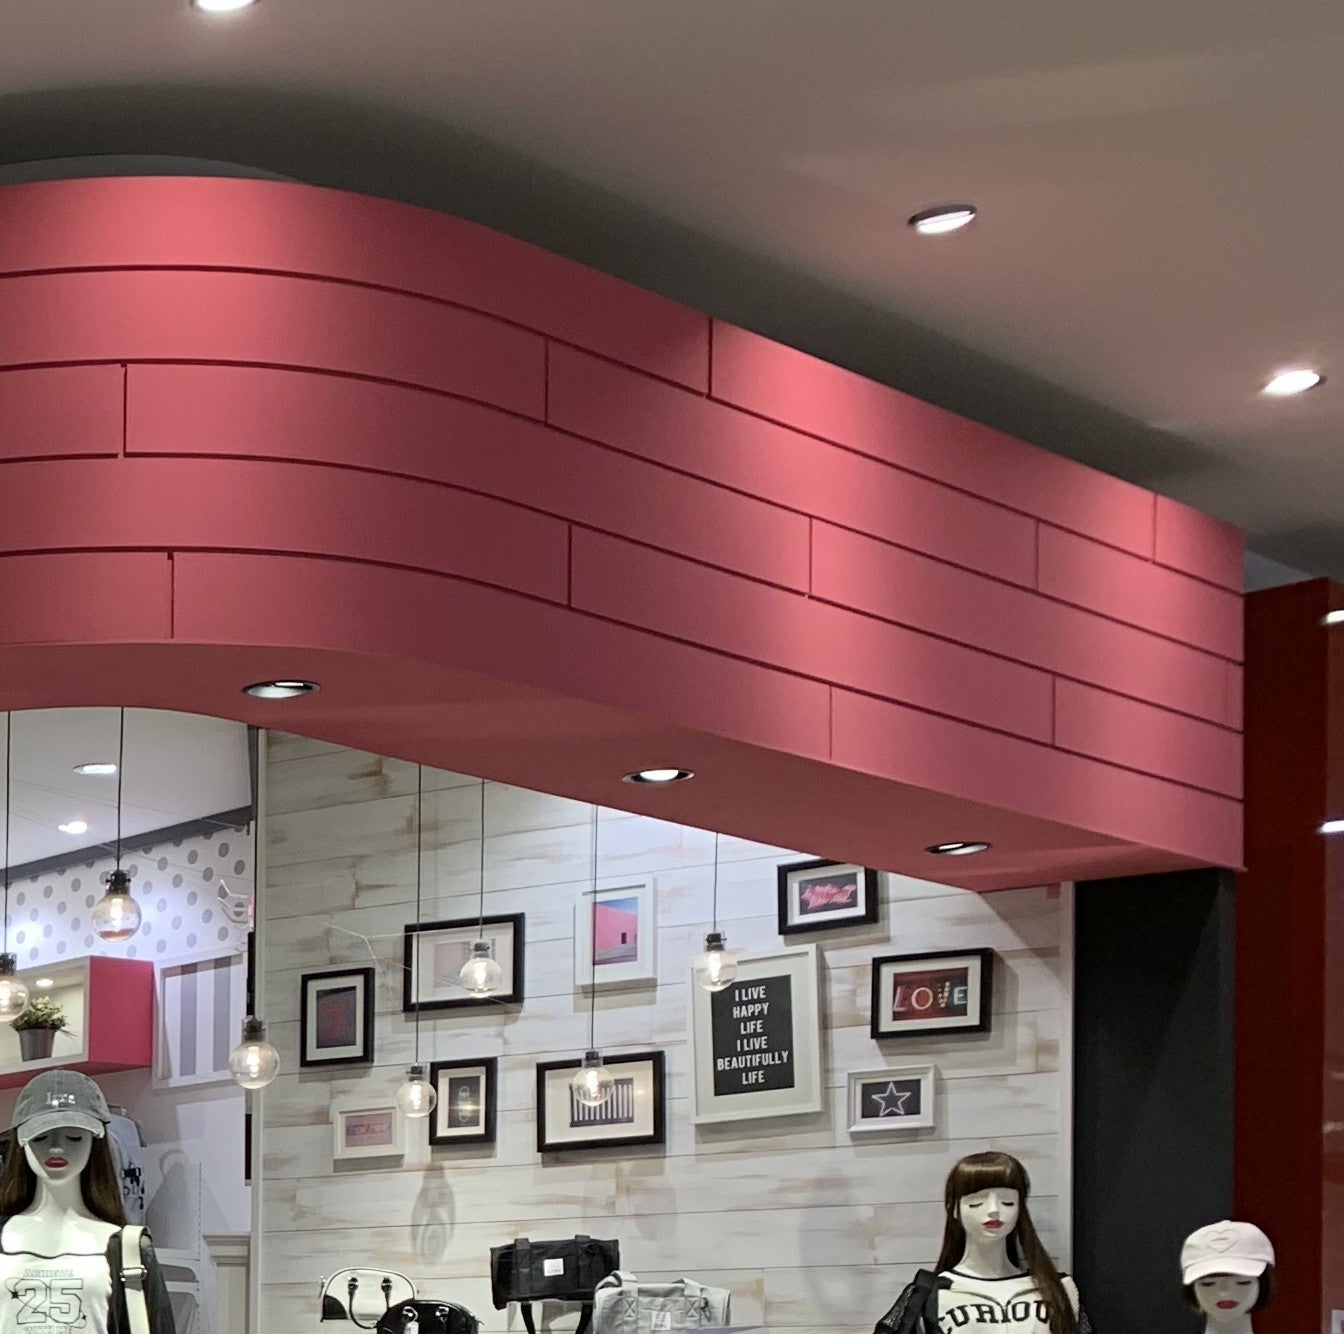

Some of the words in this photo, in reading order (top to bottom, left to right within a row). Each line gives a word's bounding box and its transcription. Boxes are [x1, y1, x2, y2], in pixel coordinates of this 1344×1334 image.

[734, 989, 740, 1001] I
[742, 986, 766, 1001] LIVE
[893, 981, 968, 1012] LOVE
[733, 1002, 769, 1018] HAPPY
[740, 1020, 764, 1035] LIFE
[737, 1039, 741, 1051] I
[743, 1036, 768, 1051] LIVE
[716, 1051, 789, 1071] BEAUTIFULLY
[742, 1070, 765, 1085] LIFE
[14, 1278, 83, 1325] 25
